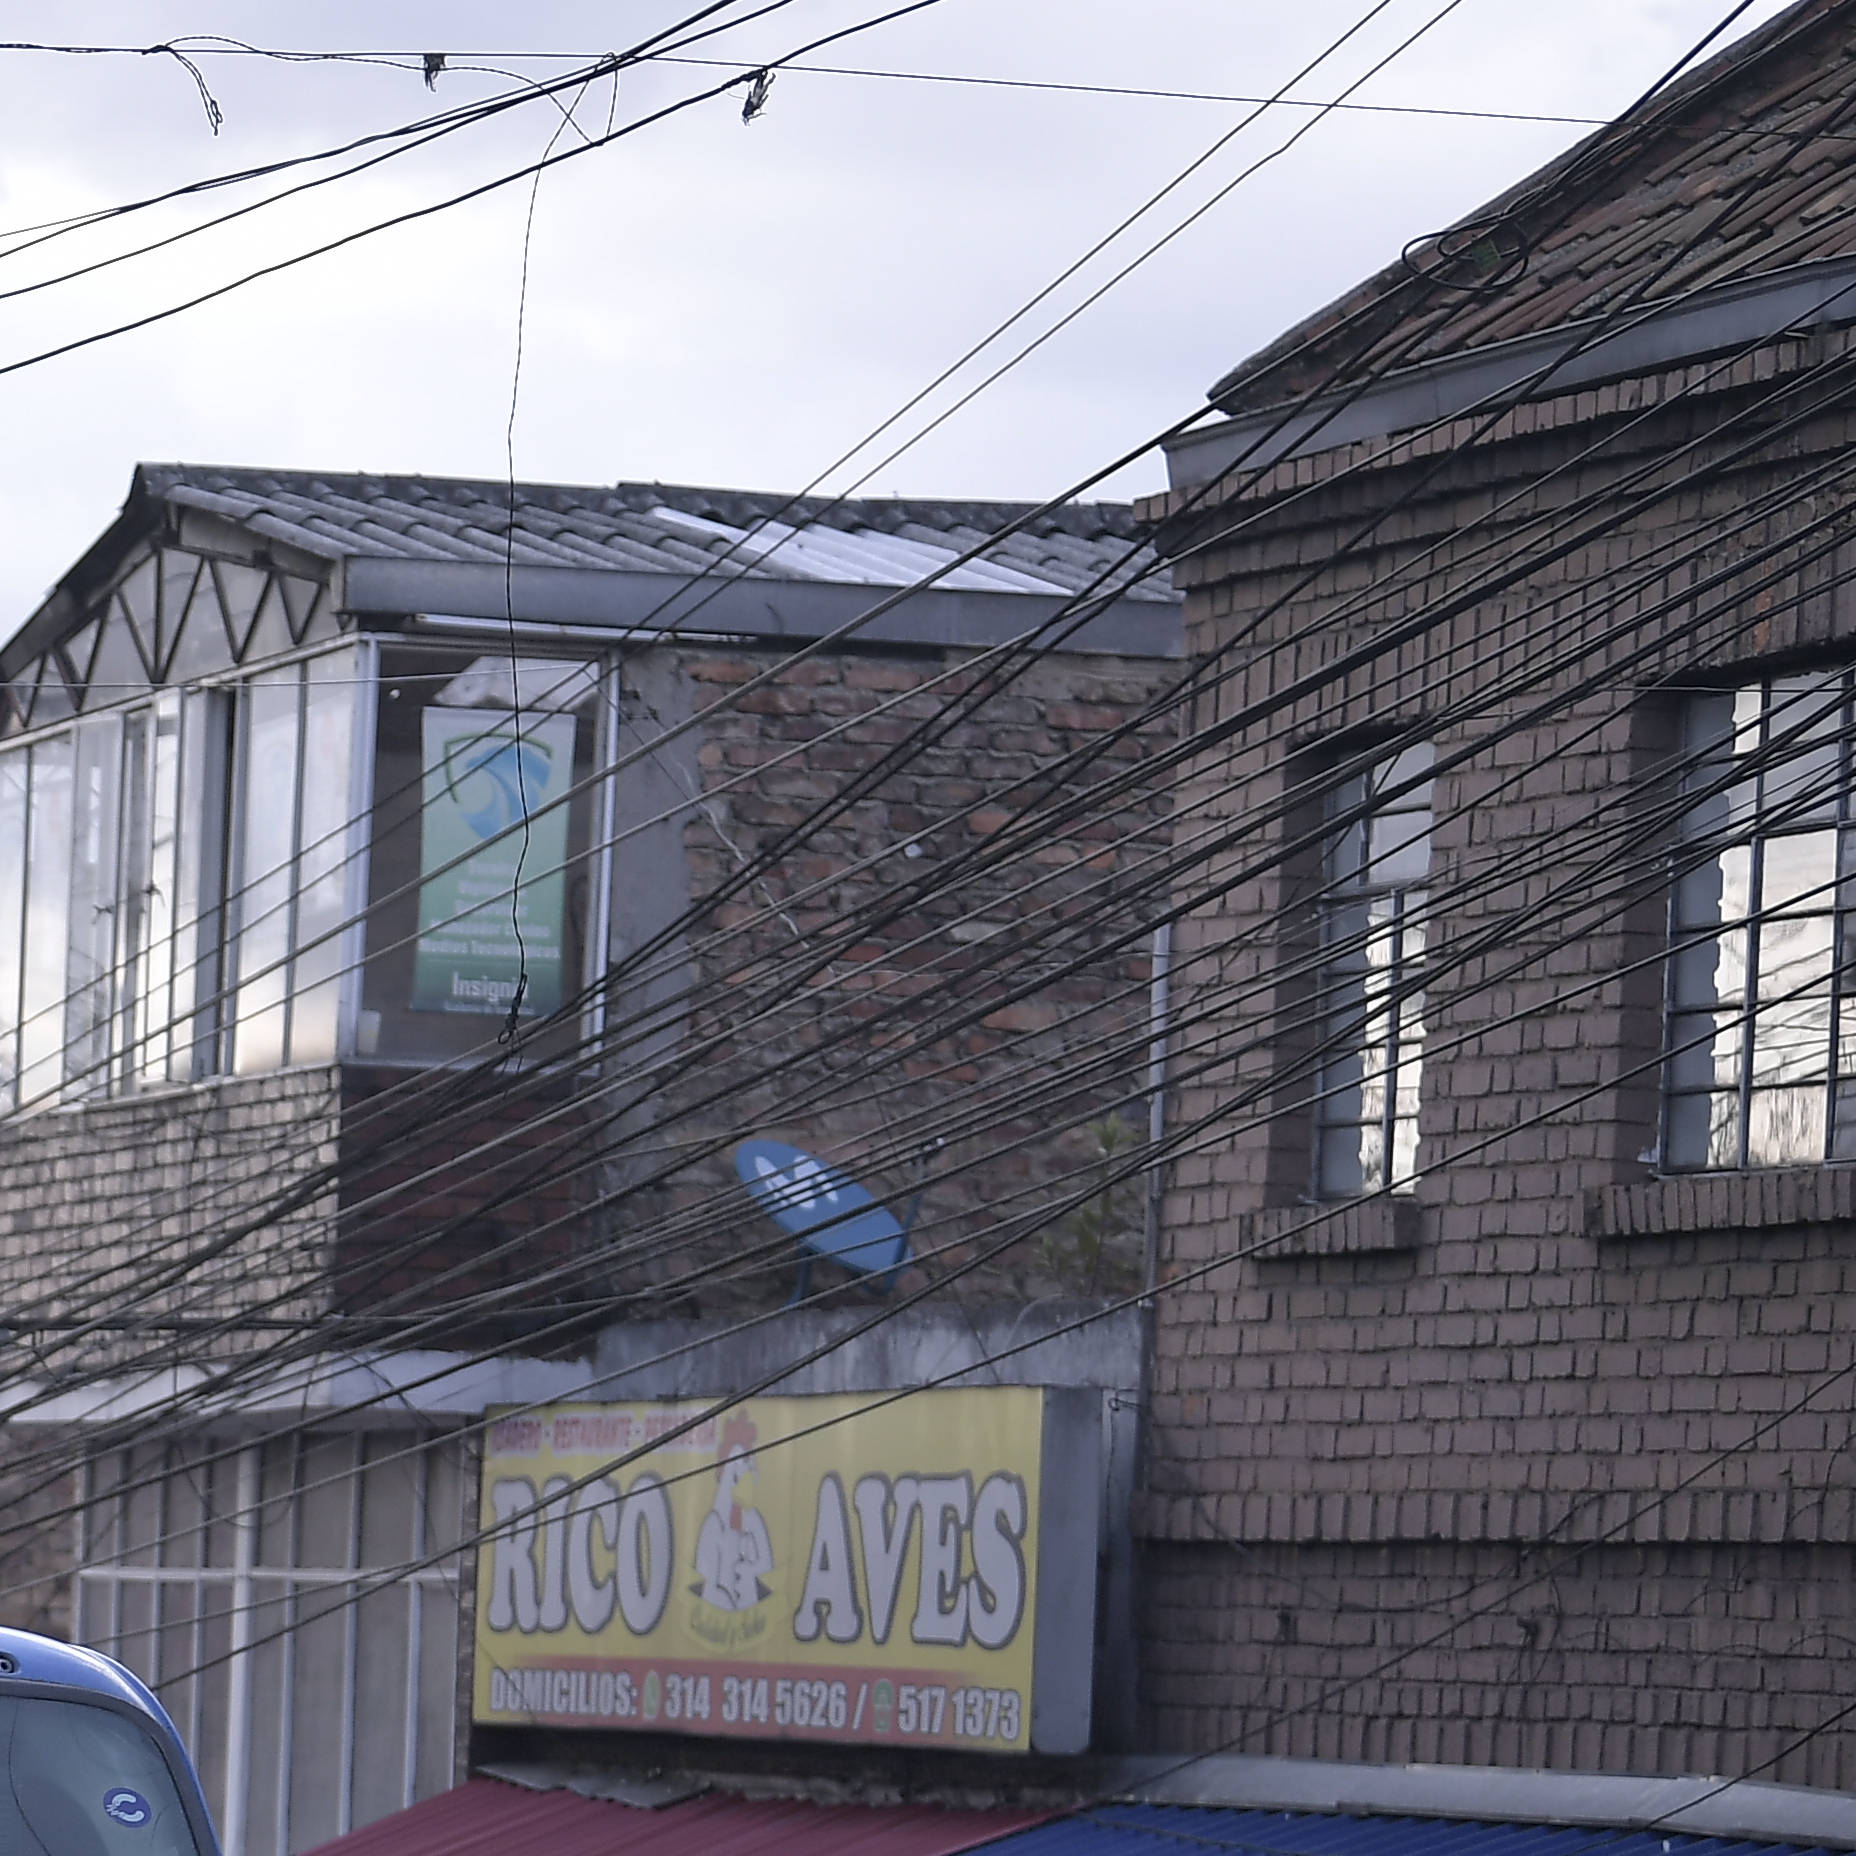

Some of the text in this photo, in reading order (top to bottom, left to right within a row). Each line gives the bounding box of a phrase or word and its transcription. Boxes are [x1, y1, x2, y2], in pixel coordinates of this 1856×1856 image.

[488, 1468, 1028, 1652] RICO AVES
[491, 1667, 638, 1716] DOMICILIOS:
[665, 1672, 711, 1721] 314
[722, 1674, 769, 1724] 314
[775, 1678, 848, 1728] 5626
[898, 1683, 947, 1734] 517
[951, 1687, 1021, 1741] 1373
